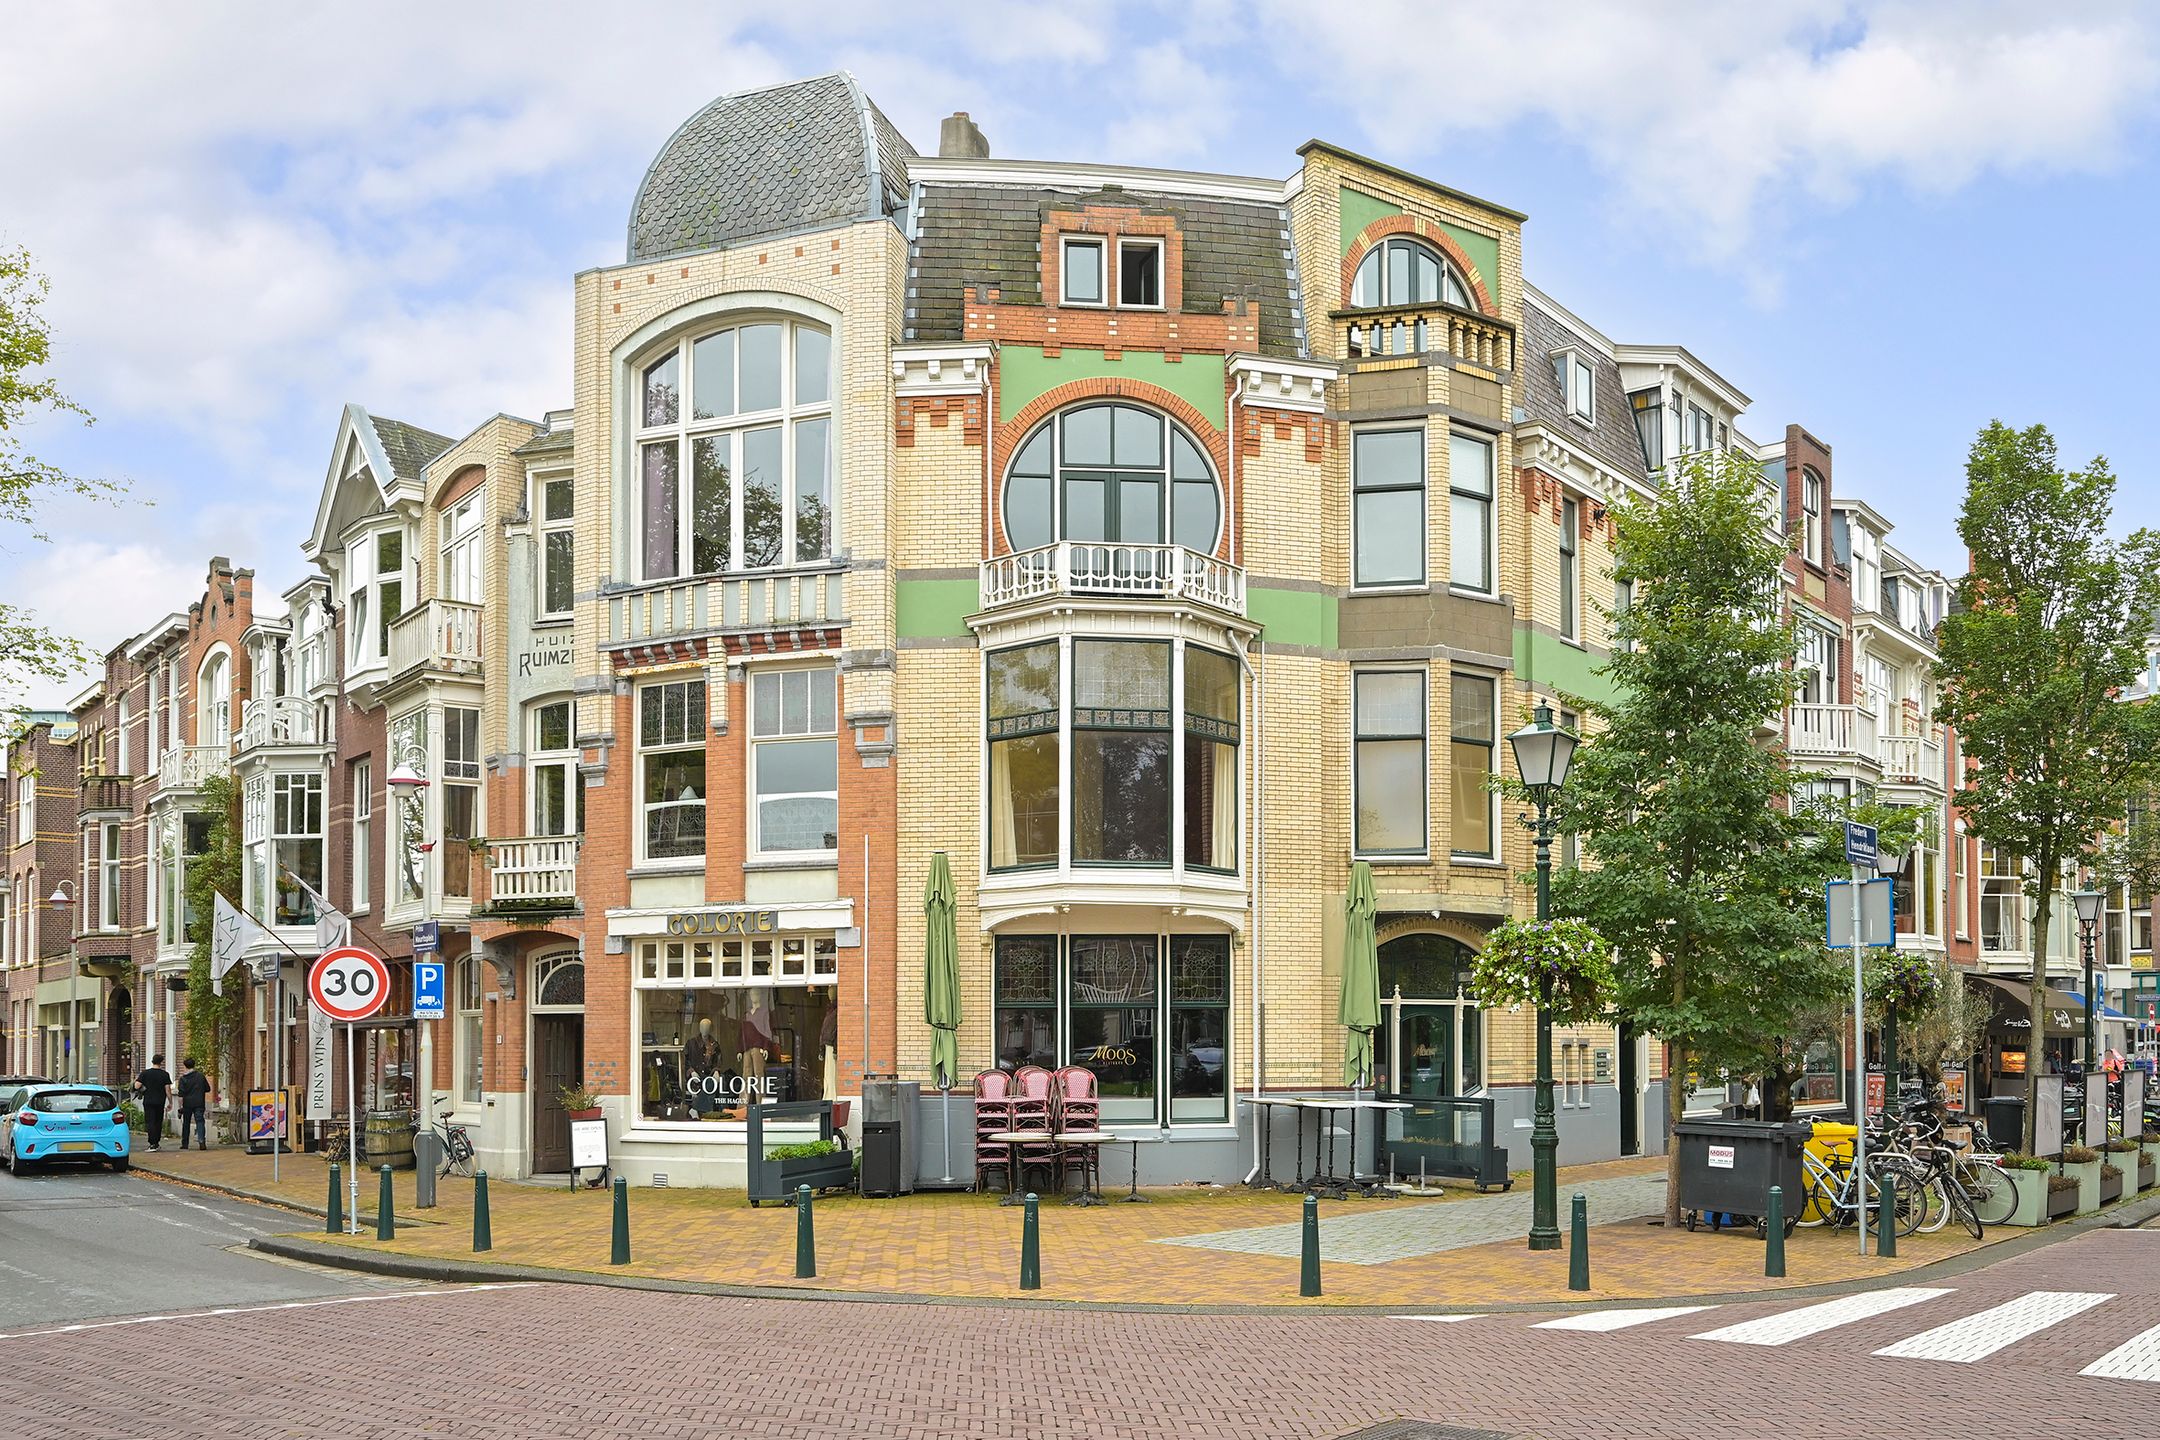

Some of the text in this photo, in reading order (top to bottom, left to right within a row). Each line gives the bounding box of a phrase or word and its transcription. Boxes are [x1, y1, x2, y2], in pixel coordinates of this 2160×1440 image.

[669, 911, 772, 937] COLORIE
[324, 969, 375, 997] 30
[421, 967, 438, 990] P
[313, 1036, 327, 1109] PRINS WIJN
[686, 1076, 778, 1095] COLORIE
[714, 1097, 726, 1105] THE
